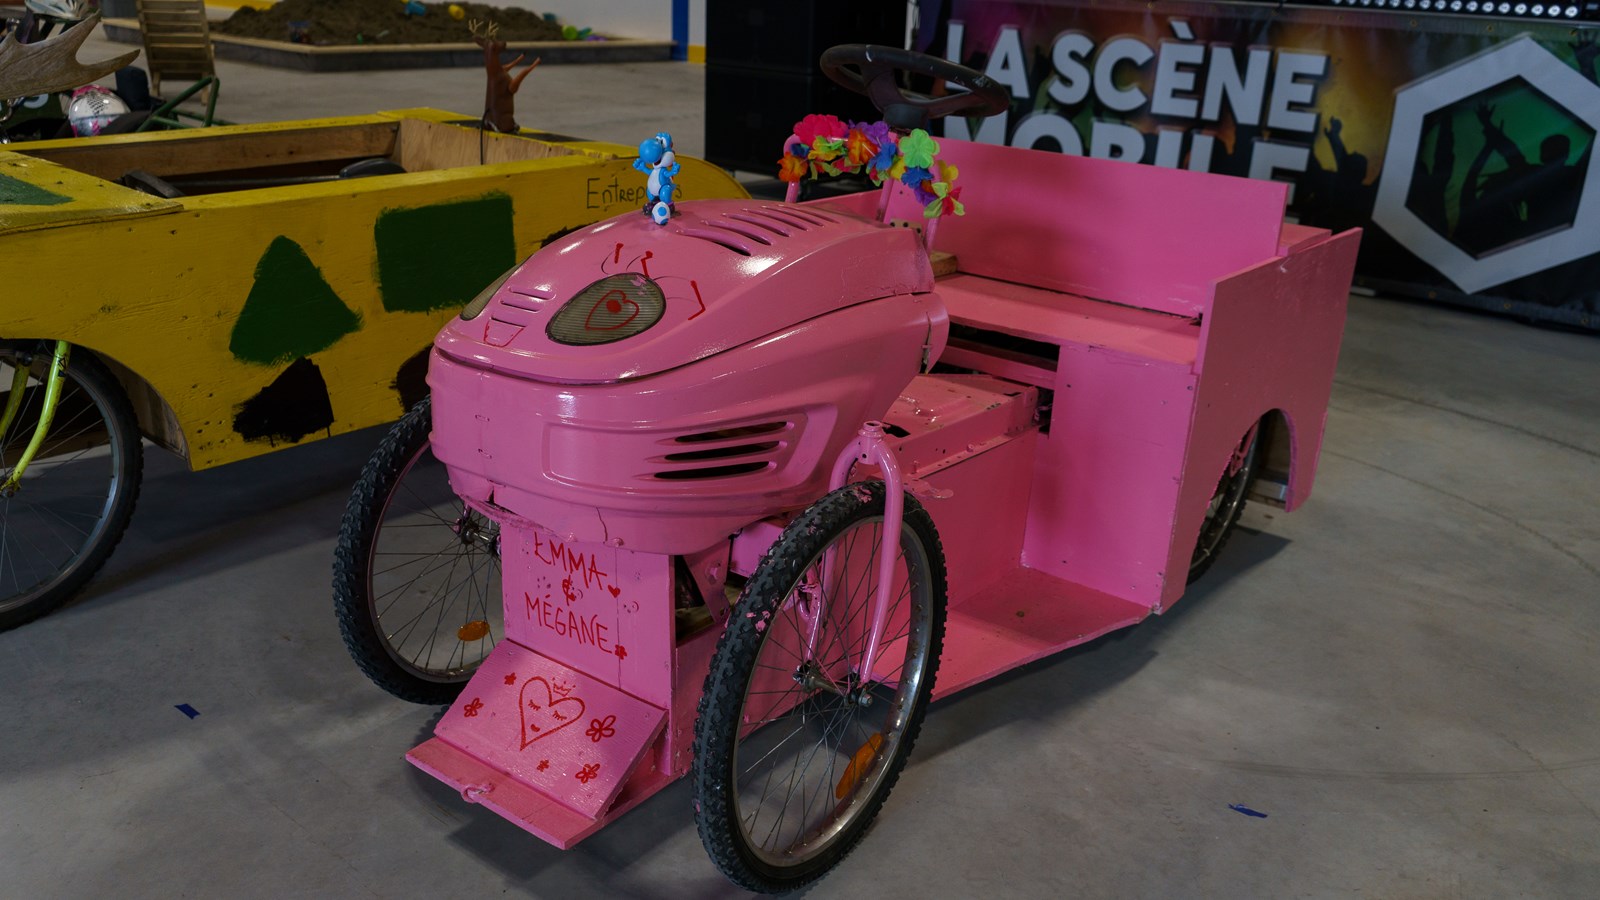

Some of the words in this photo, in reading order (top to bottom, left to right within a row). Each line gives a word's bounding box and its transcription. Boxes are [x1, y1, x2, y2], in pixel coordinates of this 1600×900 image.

[944, 21, 1031, 99] LA
[1048, 18, 1328, 133] SCÈNE
[534, 531, 608, 591] EMMA
[524, 591, 613, 654] MÉGANE
